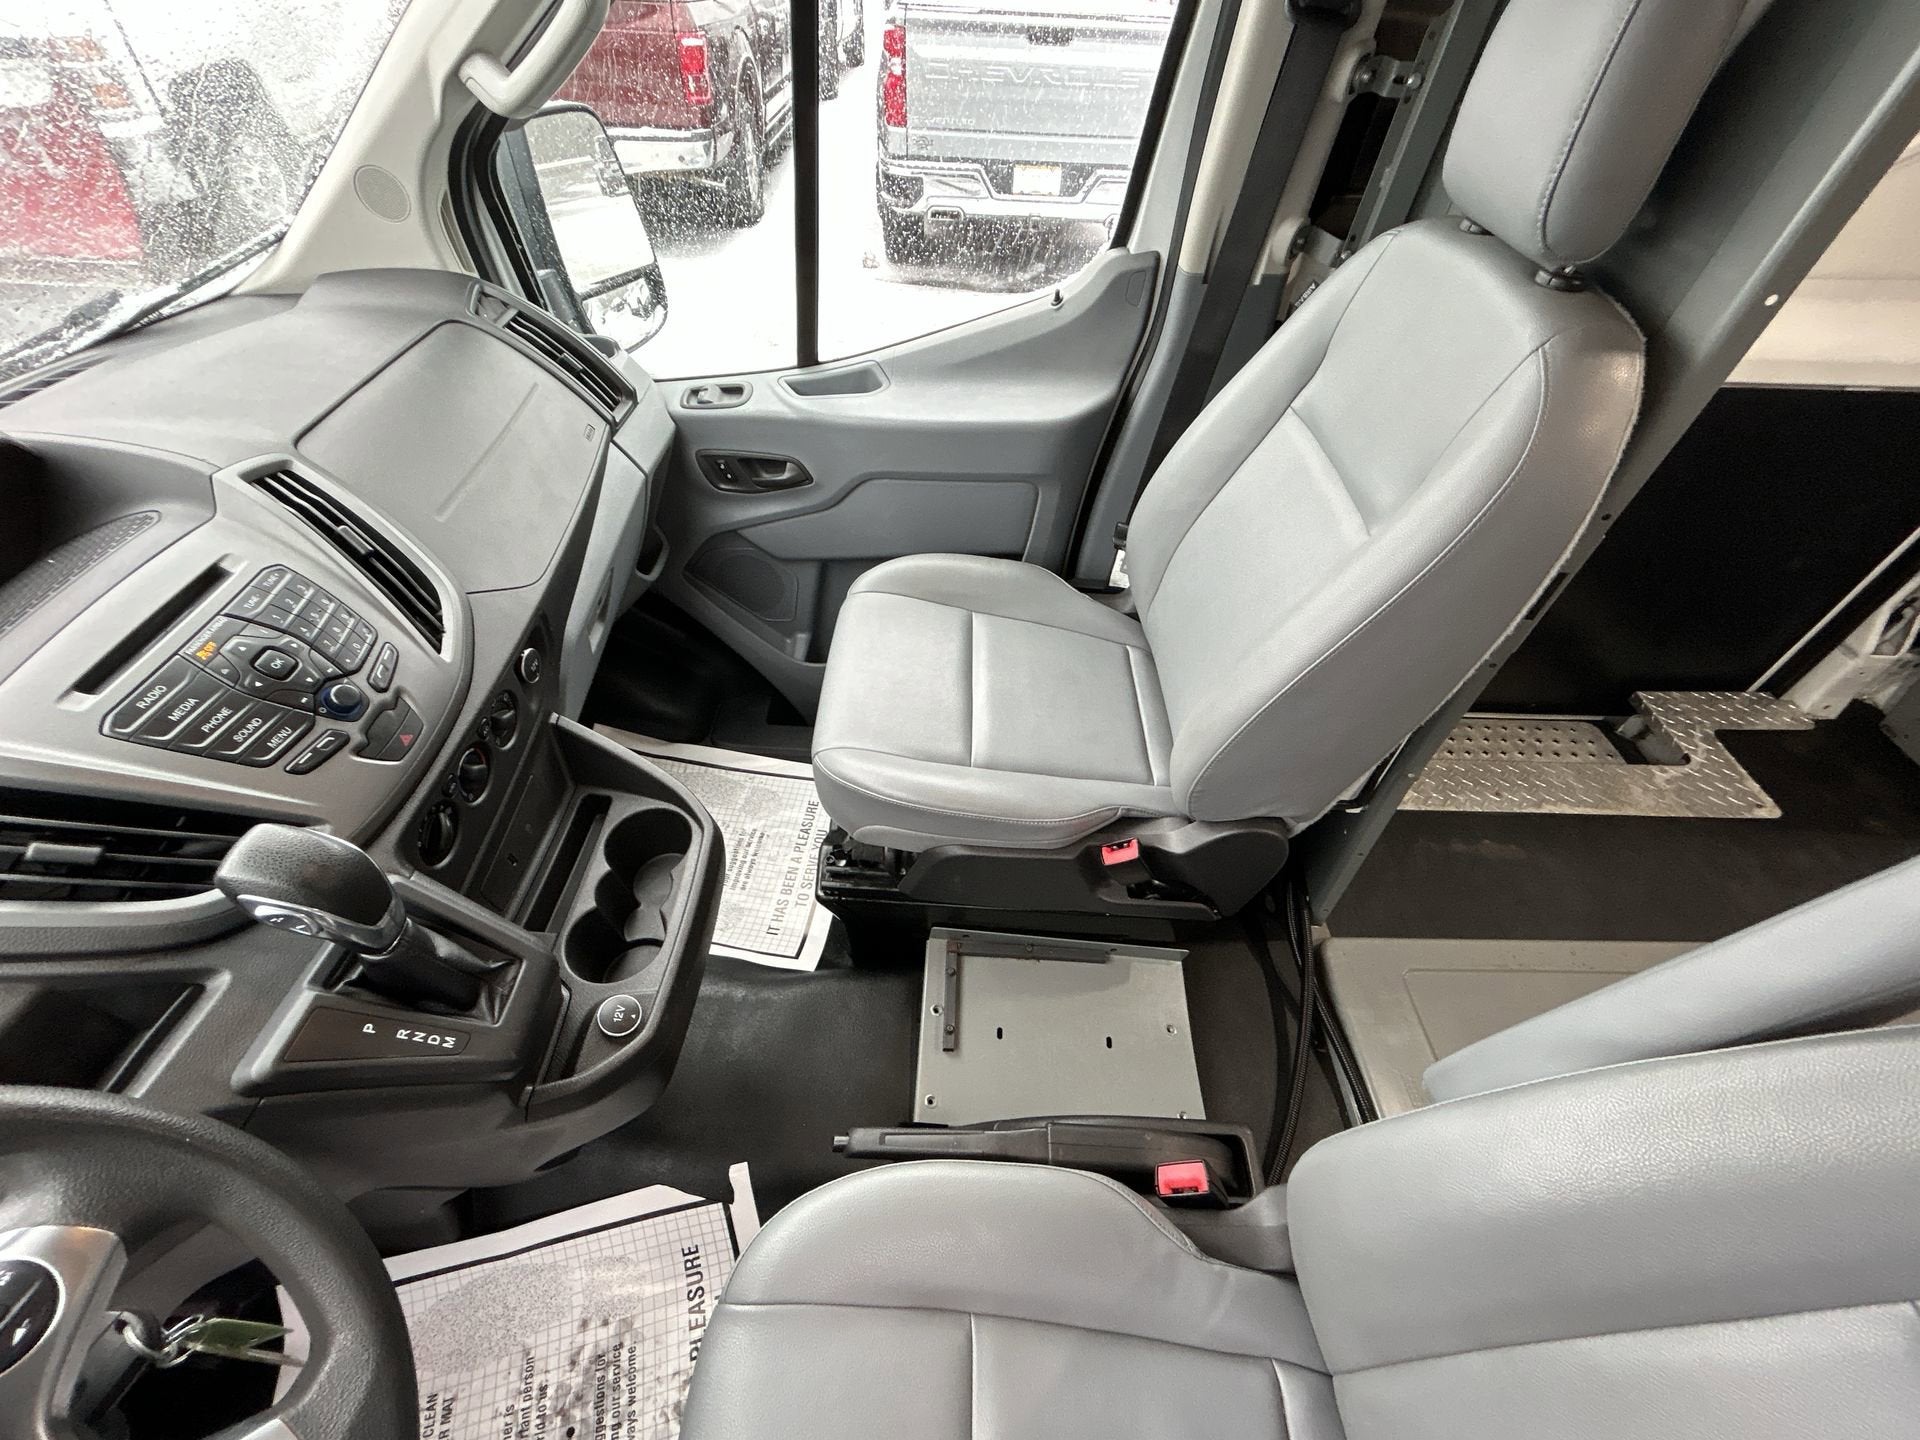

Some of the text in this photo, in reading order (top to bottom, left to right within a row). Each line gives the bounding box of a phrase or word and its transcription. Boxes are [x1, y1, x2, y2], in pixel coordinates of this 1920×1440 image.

[270, 658, 285, 669] OK
[135, 685, 168, 710] RADIO
[168, 698, 200, 722] MEDIA
[201, 706, 234, 733] PHONE
[233, 717, 263, 743] SOUND
[266, 726, 293, 749] MENU
[765, 800, 820, 936] IT HAS BEEN A PLEASURE
[795, 829, 828, 908] TO SERVE YOU
[613, 1004, 626, 1023] 12V
[362, 1023, 457, 1049] P R N D M
[595, 1353, 606, 1372] for
[612, 1343, 622, 1393] service
[626, 1341, 637, 1407] welcome.
[522, 1356, 535, 1403] person
[422, 1393, 438, 1439] CLEAN
[440, 1396, 455, 1426] MAT
[503, 1404, 515, 1418] is
[535, 1404, 547, 1420] to
[612, 1396, 621, 1420] our
